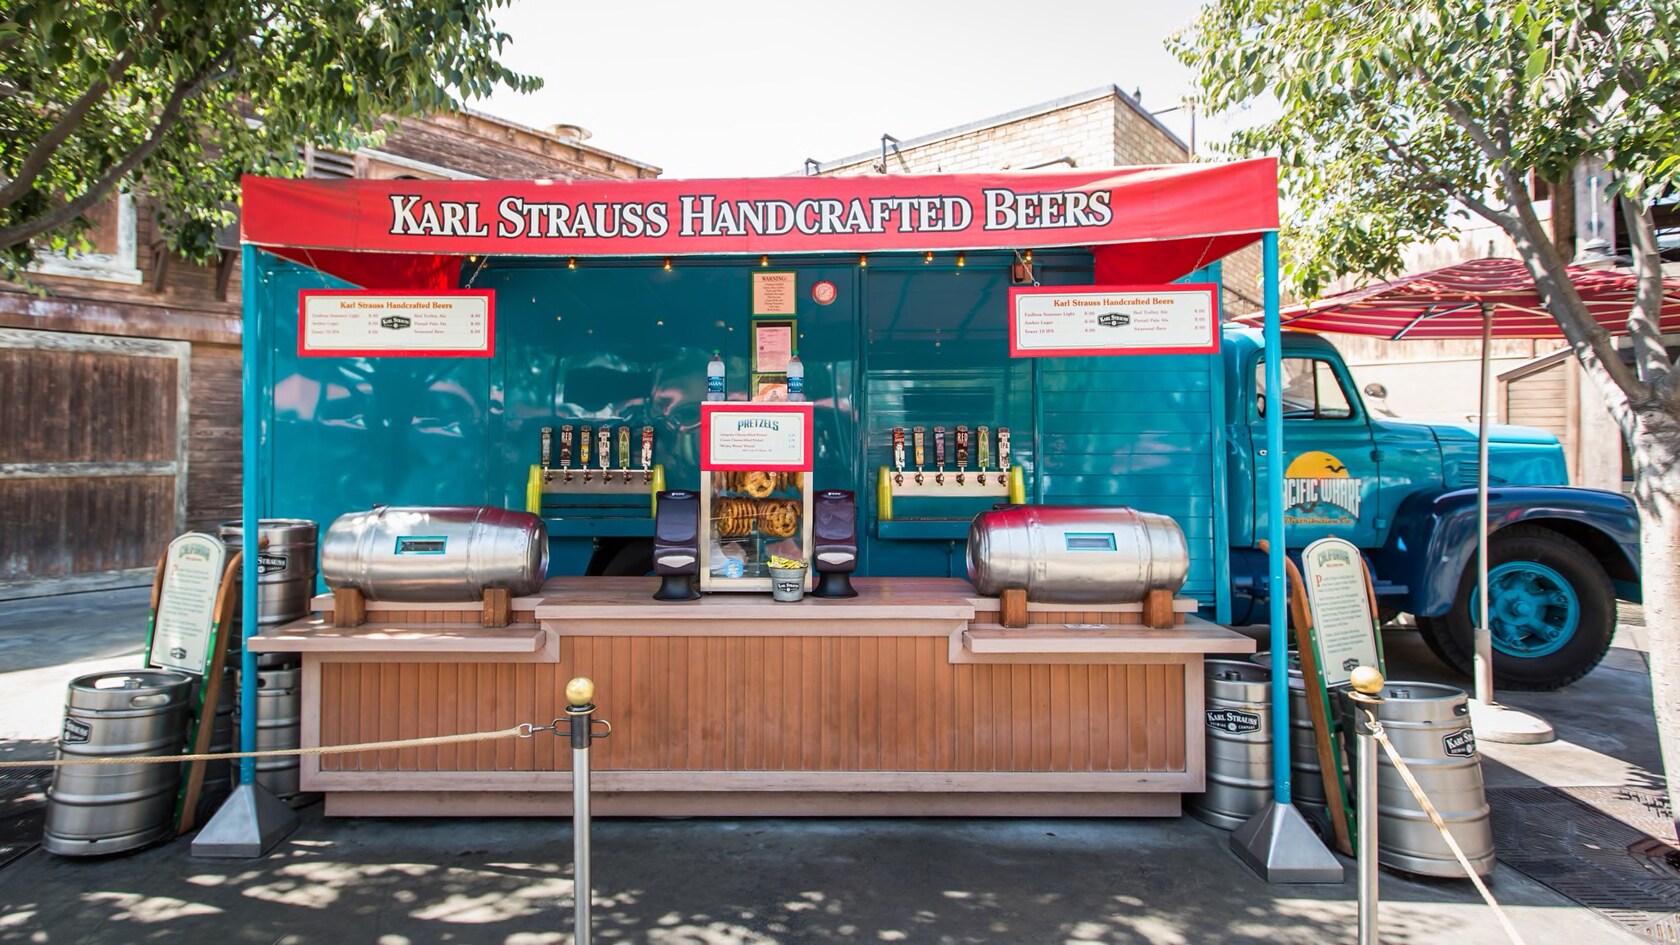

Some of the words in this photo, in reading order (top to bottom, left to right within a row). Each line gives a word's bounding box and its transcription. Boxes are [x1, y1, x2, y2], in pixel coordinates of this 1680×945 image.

[389, 194, 488, 237] KARL
[498, 196, 669, 239] STRAUSS
[678, 193, 973, 238] HANDCRAFTED
[982, 188, 1112, 231] BEERS
[340, 302, 356, 310] Karl
[358, 302, 384, 310] Strauss
[386, 302, 431, 310] Handcrafted
[432, 302, 453, 310] Beers
[1053, 299, 1070, 307] Karl
[1072, 298, 1100, 307] Strauss
[1102, 298, 1150, 306] Handcrafted
[1152, 297, 1174, 306] Beers
[737, 418, 779, 432] PRETZELS
[1283, 478, 1319, 512] ACIFIC
[1320, 478, 1362, 520] WHARF
[258, 556, 286, 566] STRAUSS
[1206, 712, 1226, 722] KARL
[1226, 712, 1258, 726] STRAUSS
[1446, 736, 1465, 750] KARL
